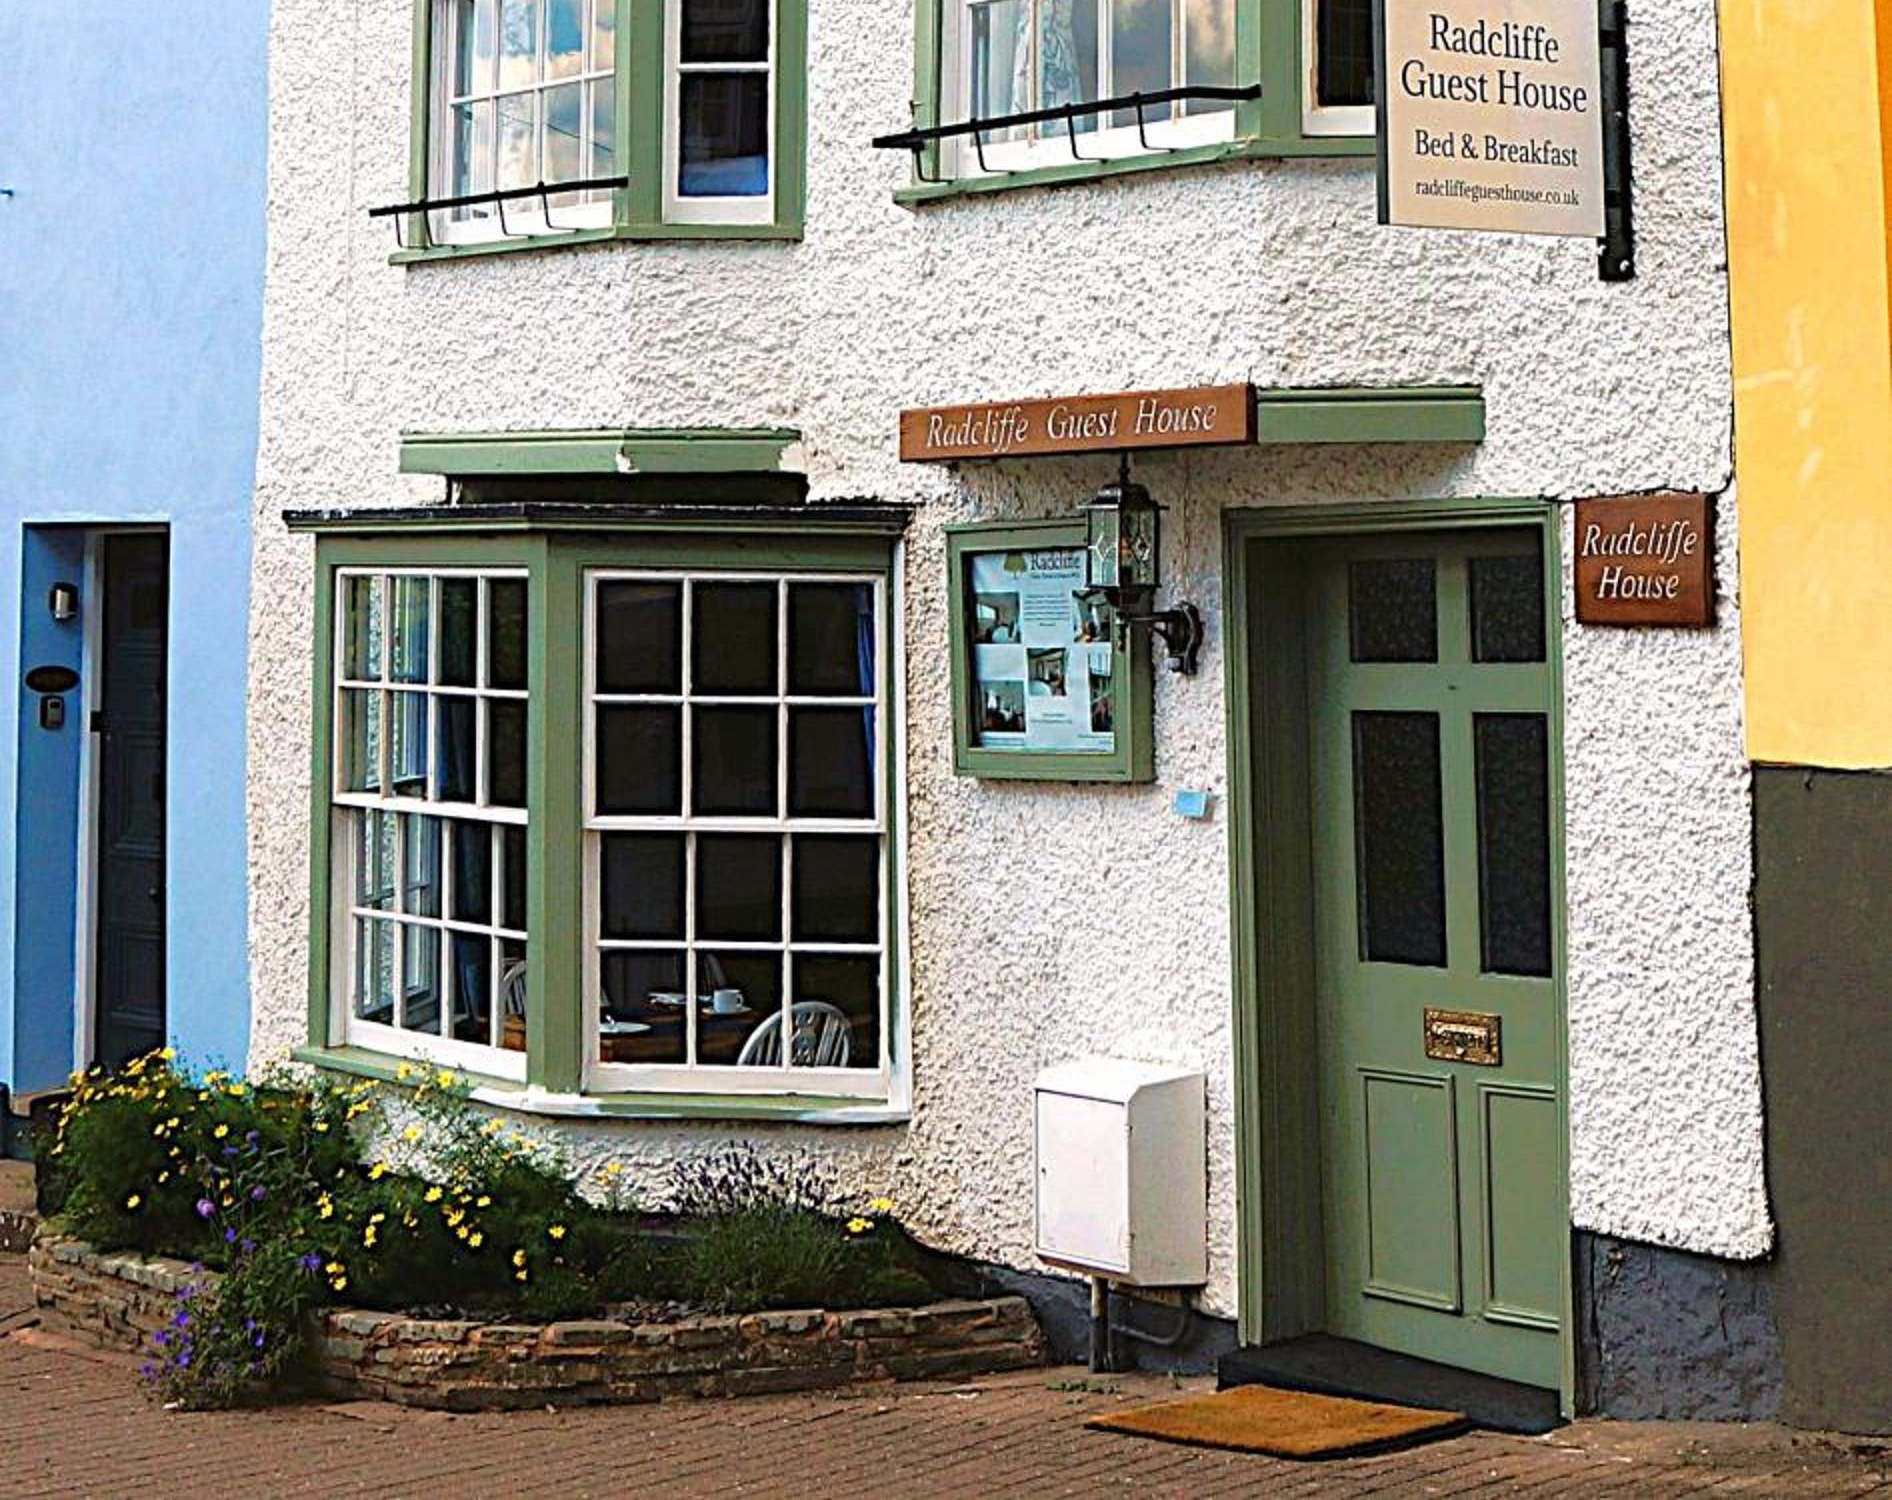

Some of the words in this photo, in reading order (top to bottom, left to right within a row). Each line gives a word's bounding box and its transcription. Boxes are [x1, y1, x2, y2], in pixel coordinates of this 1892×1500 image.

[1430, 13, 1559, 63] Radcliffe
[1401, 59, 1488, 104] Guest
[1497, 69, 1587, 113] House
[1415, 129, 1455, 158] Bed
[1461, 133, 1479, 159] &
[1484, 135, 1579, 167] Breakfast
[1415, 179, 1579, 206] radcliffeguesthouse.co.uk
[927, 406, 1029, 453] Radcliffe
[1047, 405, 1119, 440] Guest
[1135, 399, 1217, 435] House
[1581, 520, 1698, 564] Radcliffe
[1597, 565, 1680, 599] House
